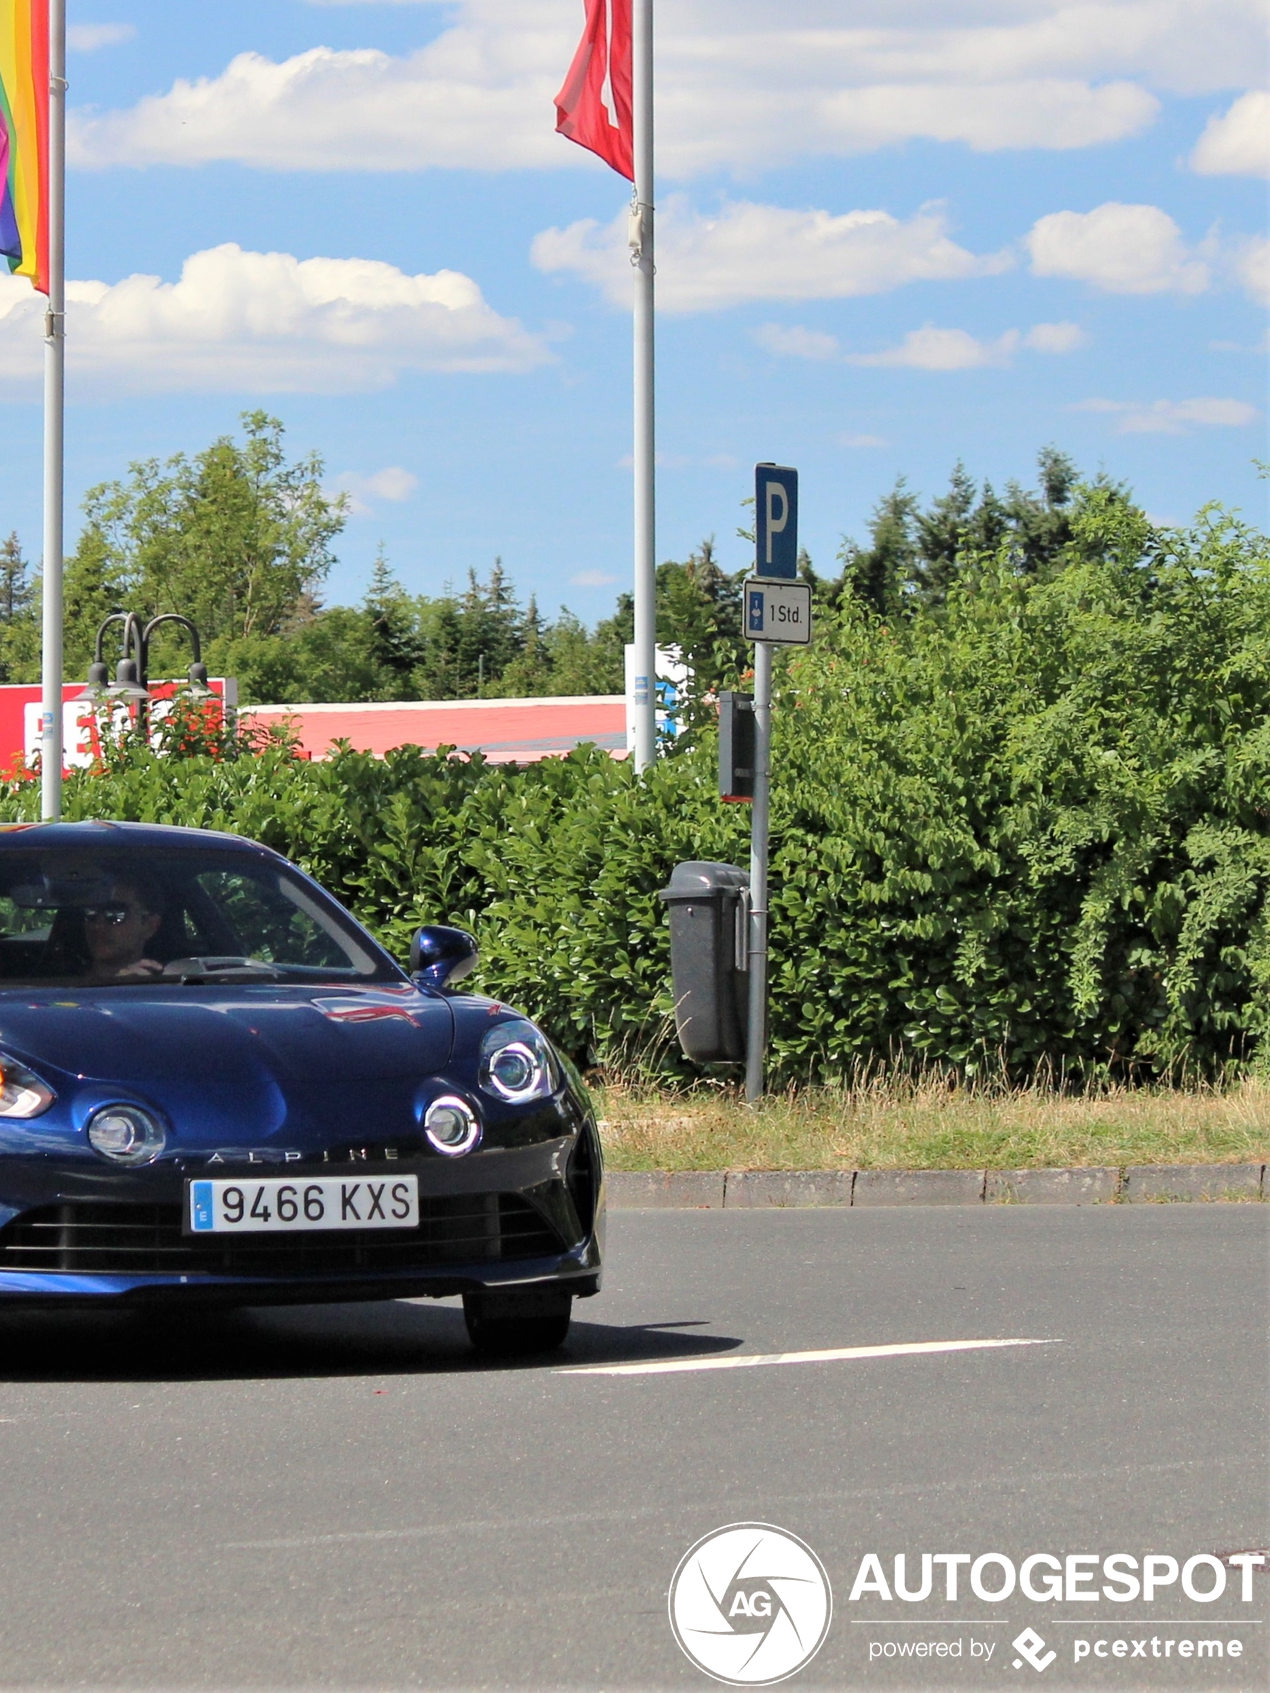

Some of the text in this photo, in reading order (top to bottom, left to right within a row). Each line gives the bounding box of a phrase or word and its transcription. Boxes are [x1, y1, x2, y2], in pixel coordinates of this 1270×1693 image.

[766, 481, 788, 564] P
[770, 605, 802, 624] 1 Std.
[208, 1148, 399, 1164] ALPINE
[222, 1183, 411, 1223] 9466 KXS
[199, 1211, 207, 1221] E
